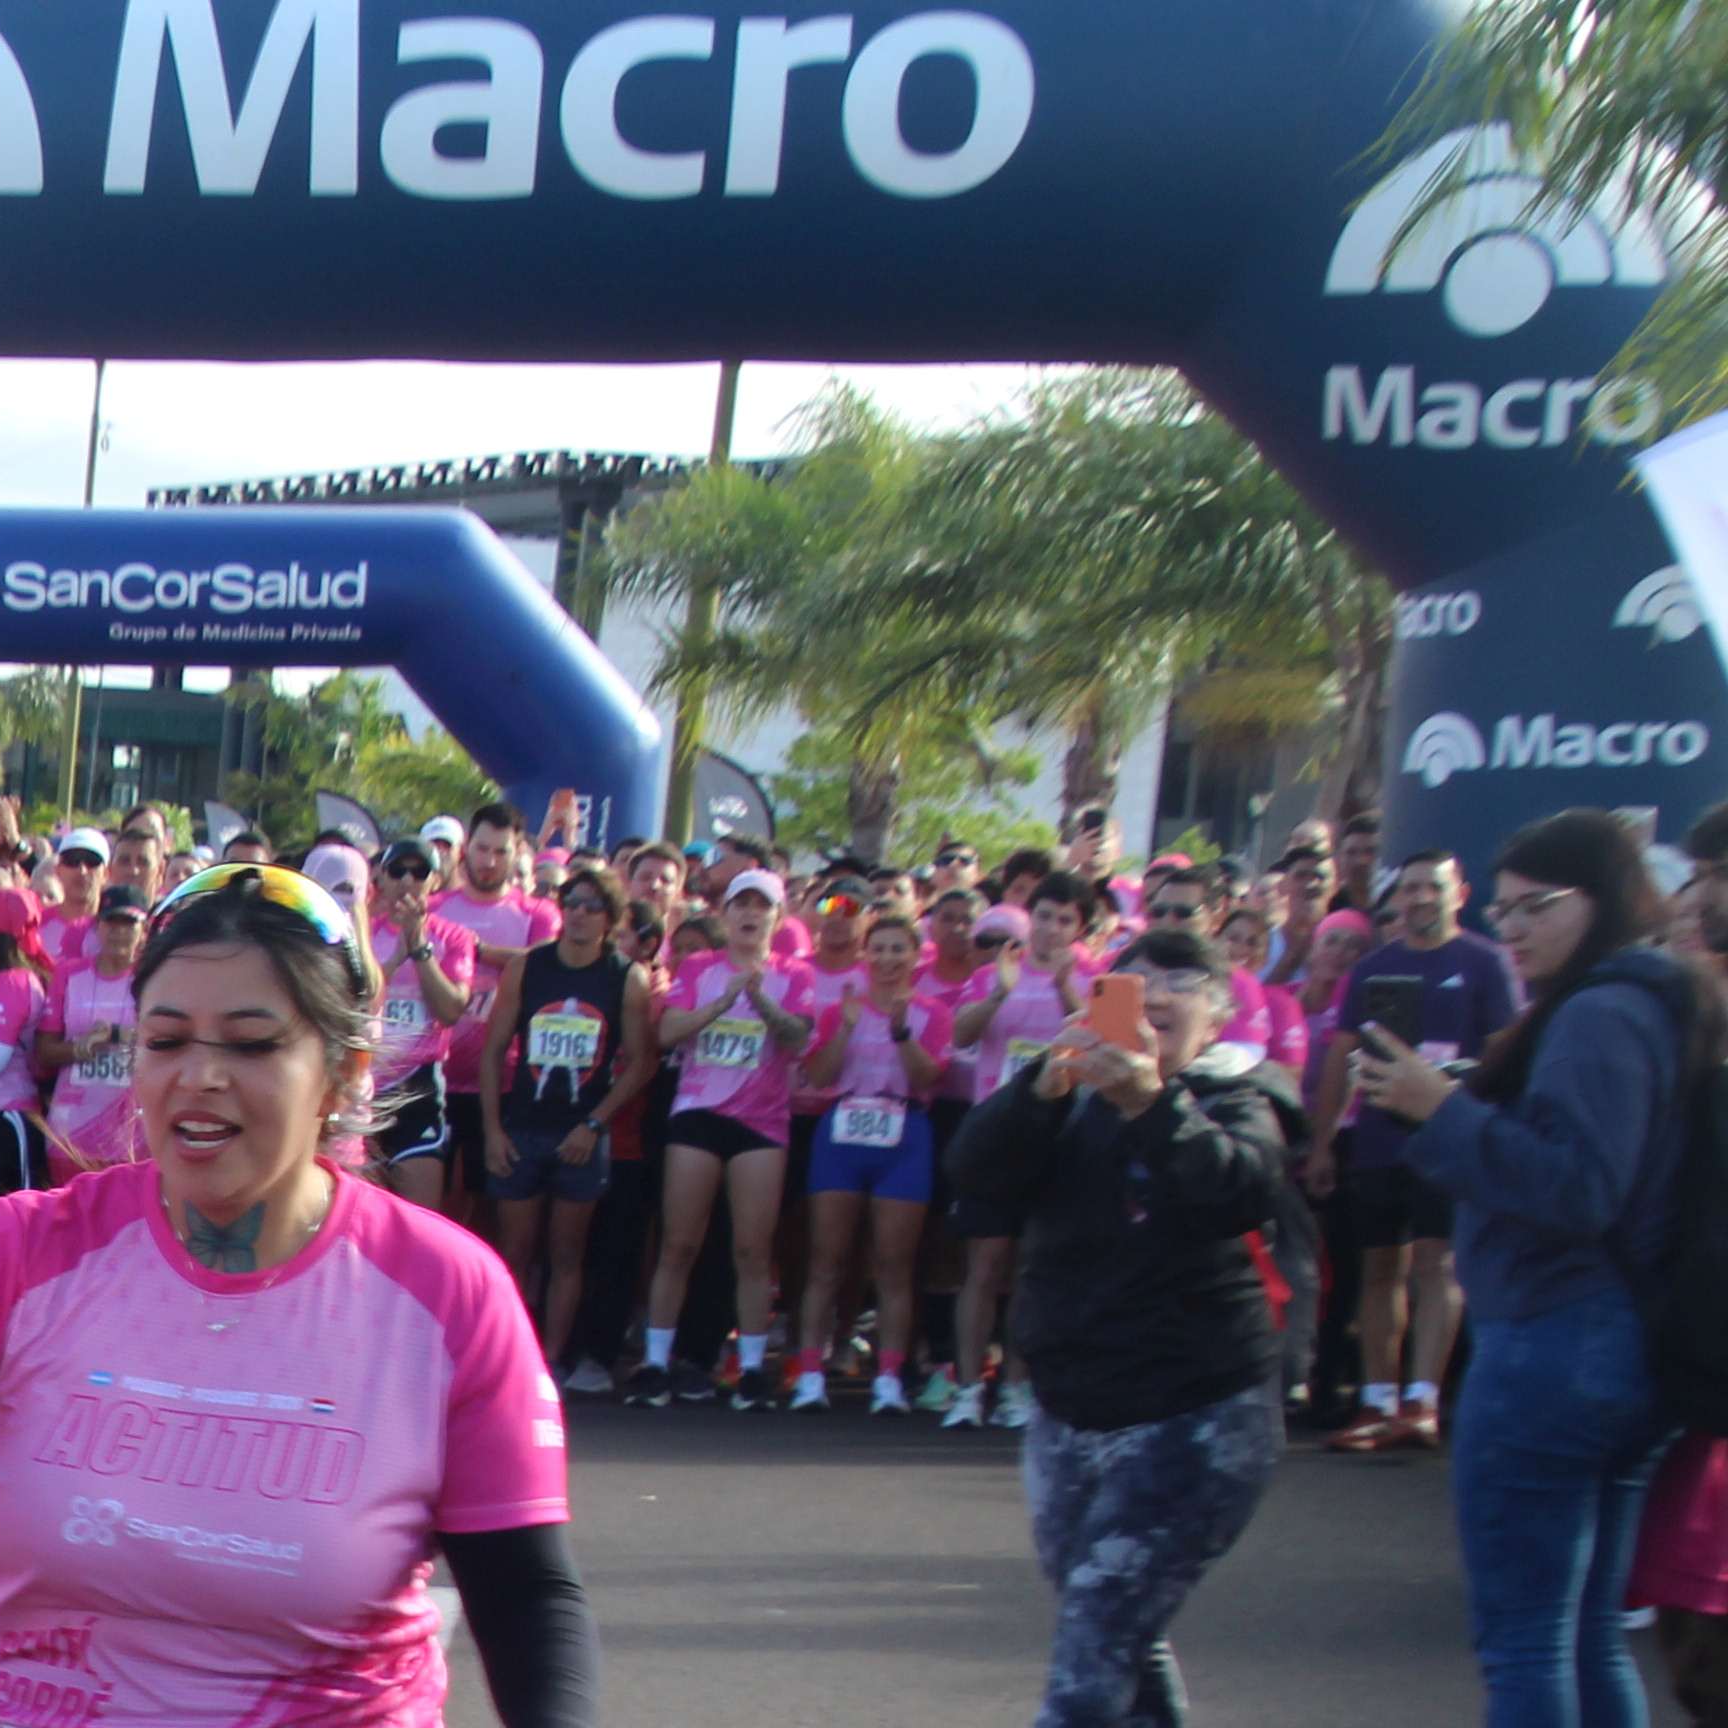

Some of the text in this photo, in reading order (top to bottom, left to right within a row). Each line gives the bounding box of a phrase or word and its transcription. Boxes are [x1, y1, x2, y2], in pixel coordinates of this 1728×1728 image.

[102, 0, 1035, 199] Macro
[1322, 364, 1660, 449] Macro
[2, 560, 368, 613] SanCorSalud
[109, 622, 363, 642] Grupo de Medicina Privada
[1489, 713, 1710, 769] Macro
[32, 1392, 366, 1506] ACTITUD
